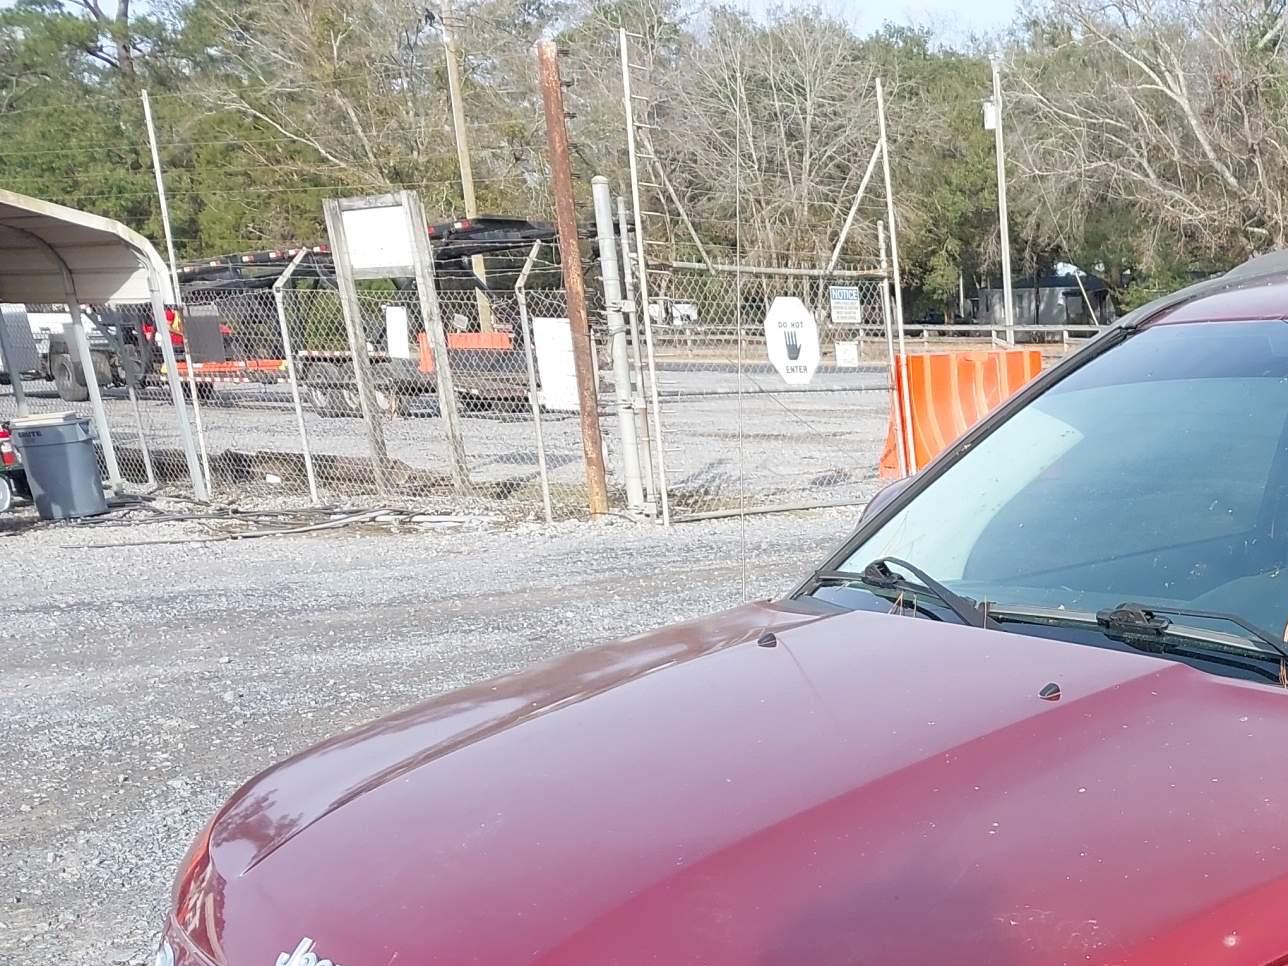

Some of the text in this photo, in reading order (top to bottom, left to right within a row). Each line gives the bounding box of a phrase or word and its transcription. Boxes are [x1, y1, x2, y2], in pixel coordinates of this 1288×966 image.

[831, 289, 858, 300] NOTICE
[778, 321, 804, 329] DO NOT
[785, 365, 808, 374] ENTER
